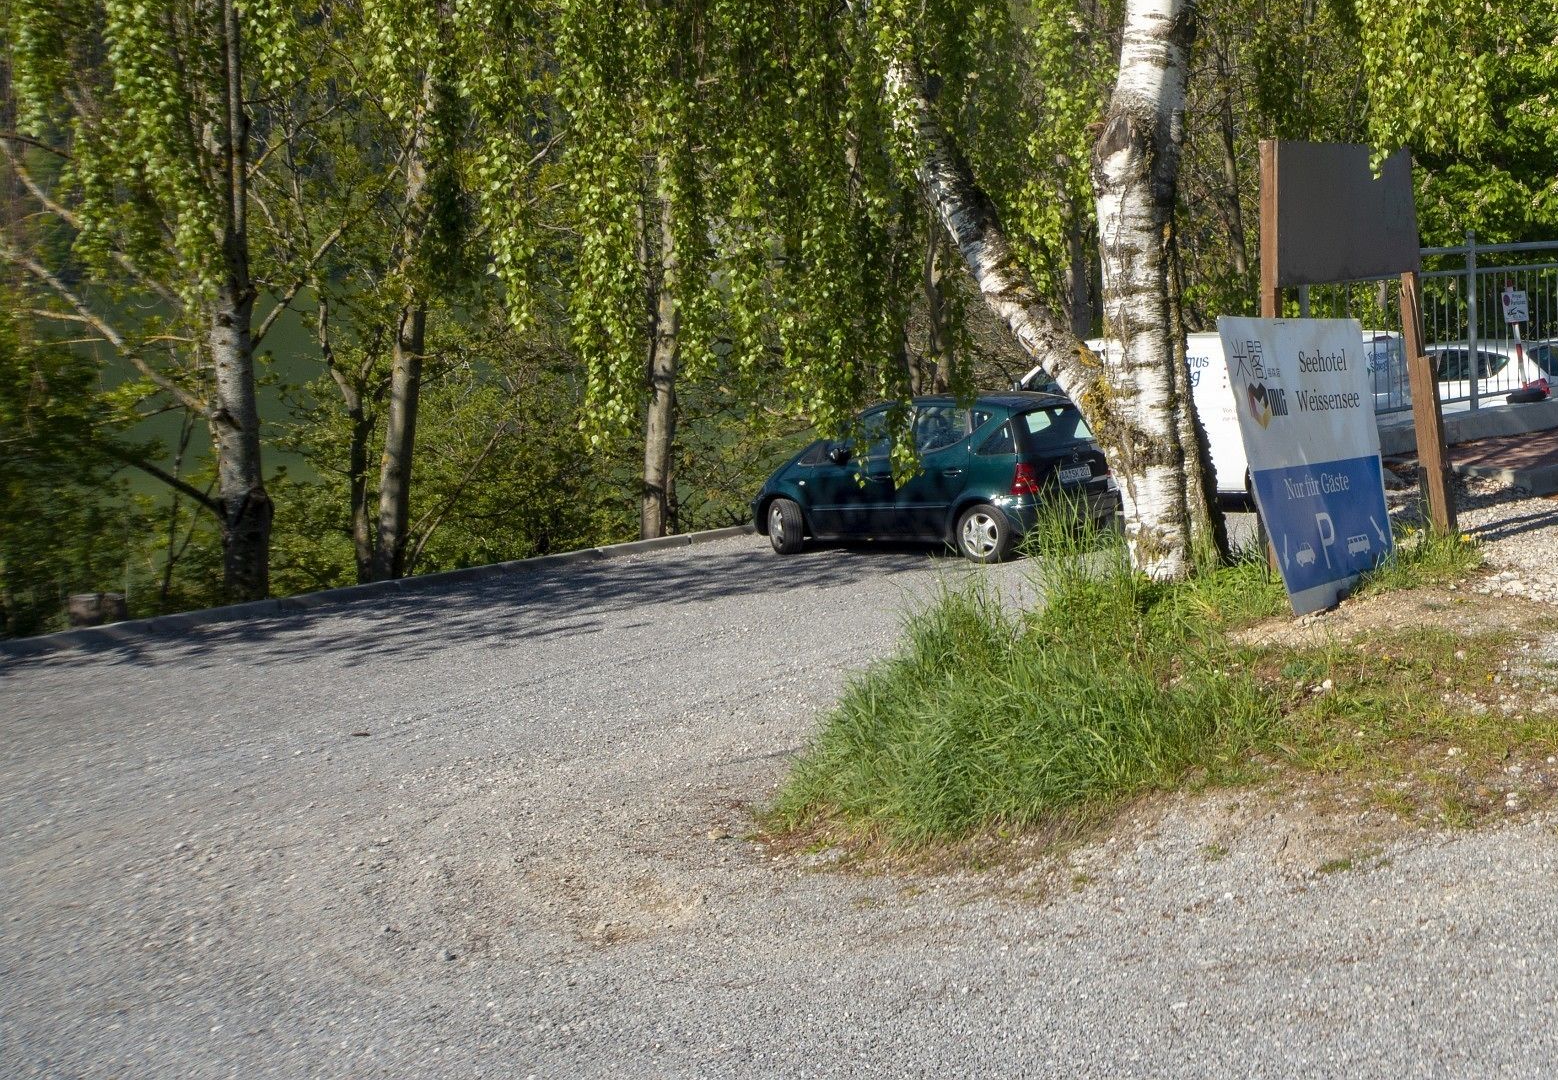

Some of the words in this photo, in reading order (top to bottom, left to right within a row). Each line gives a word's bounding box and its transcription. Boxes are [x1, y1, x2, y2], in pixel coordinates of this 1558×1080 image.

[1298, 348, 1348, 373] Seehotel
[1295, 388, 1361, 412] Weissensee
[1283, 477, 1304, 500] Nur
[1304, 473, 1321, 497] für
[1320, 472, 1350, 495] Gäste
[1315, 512, 1335, 570] P
